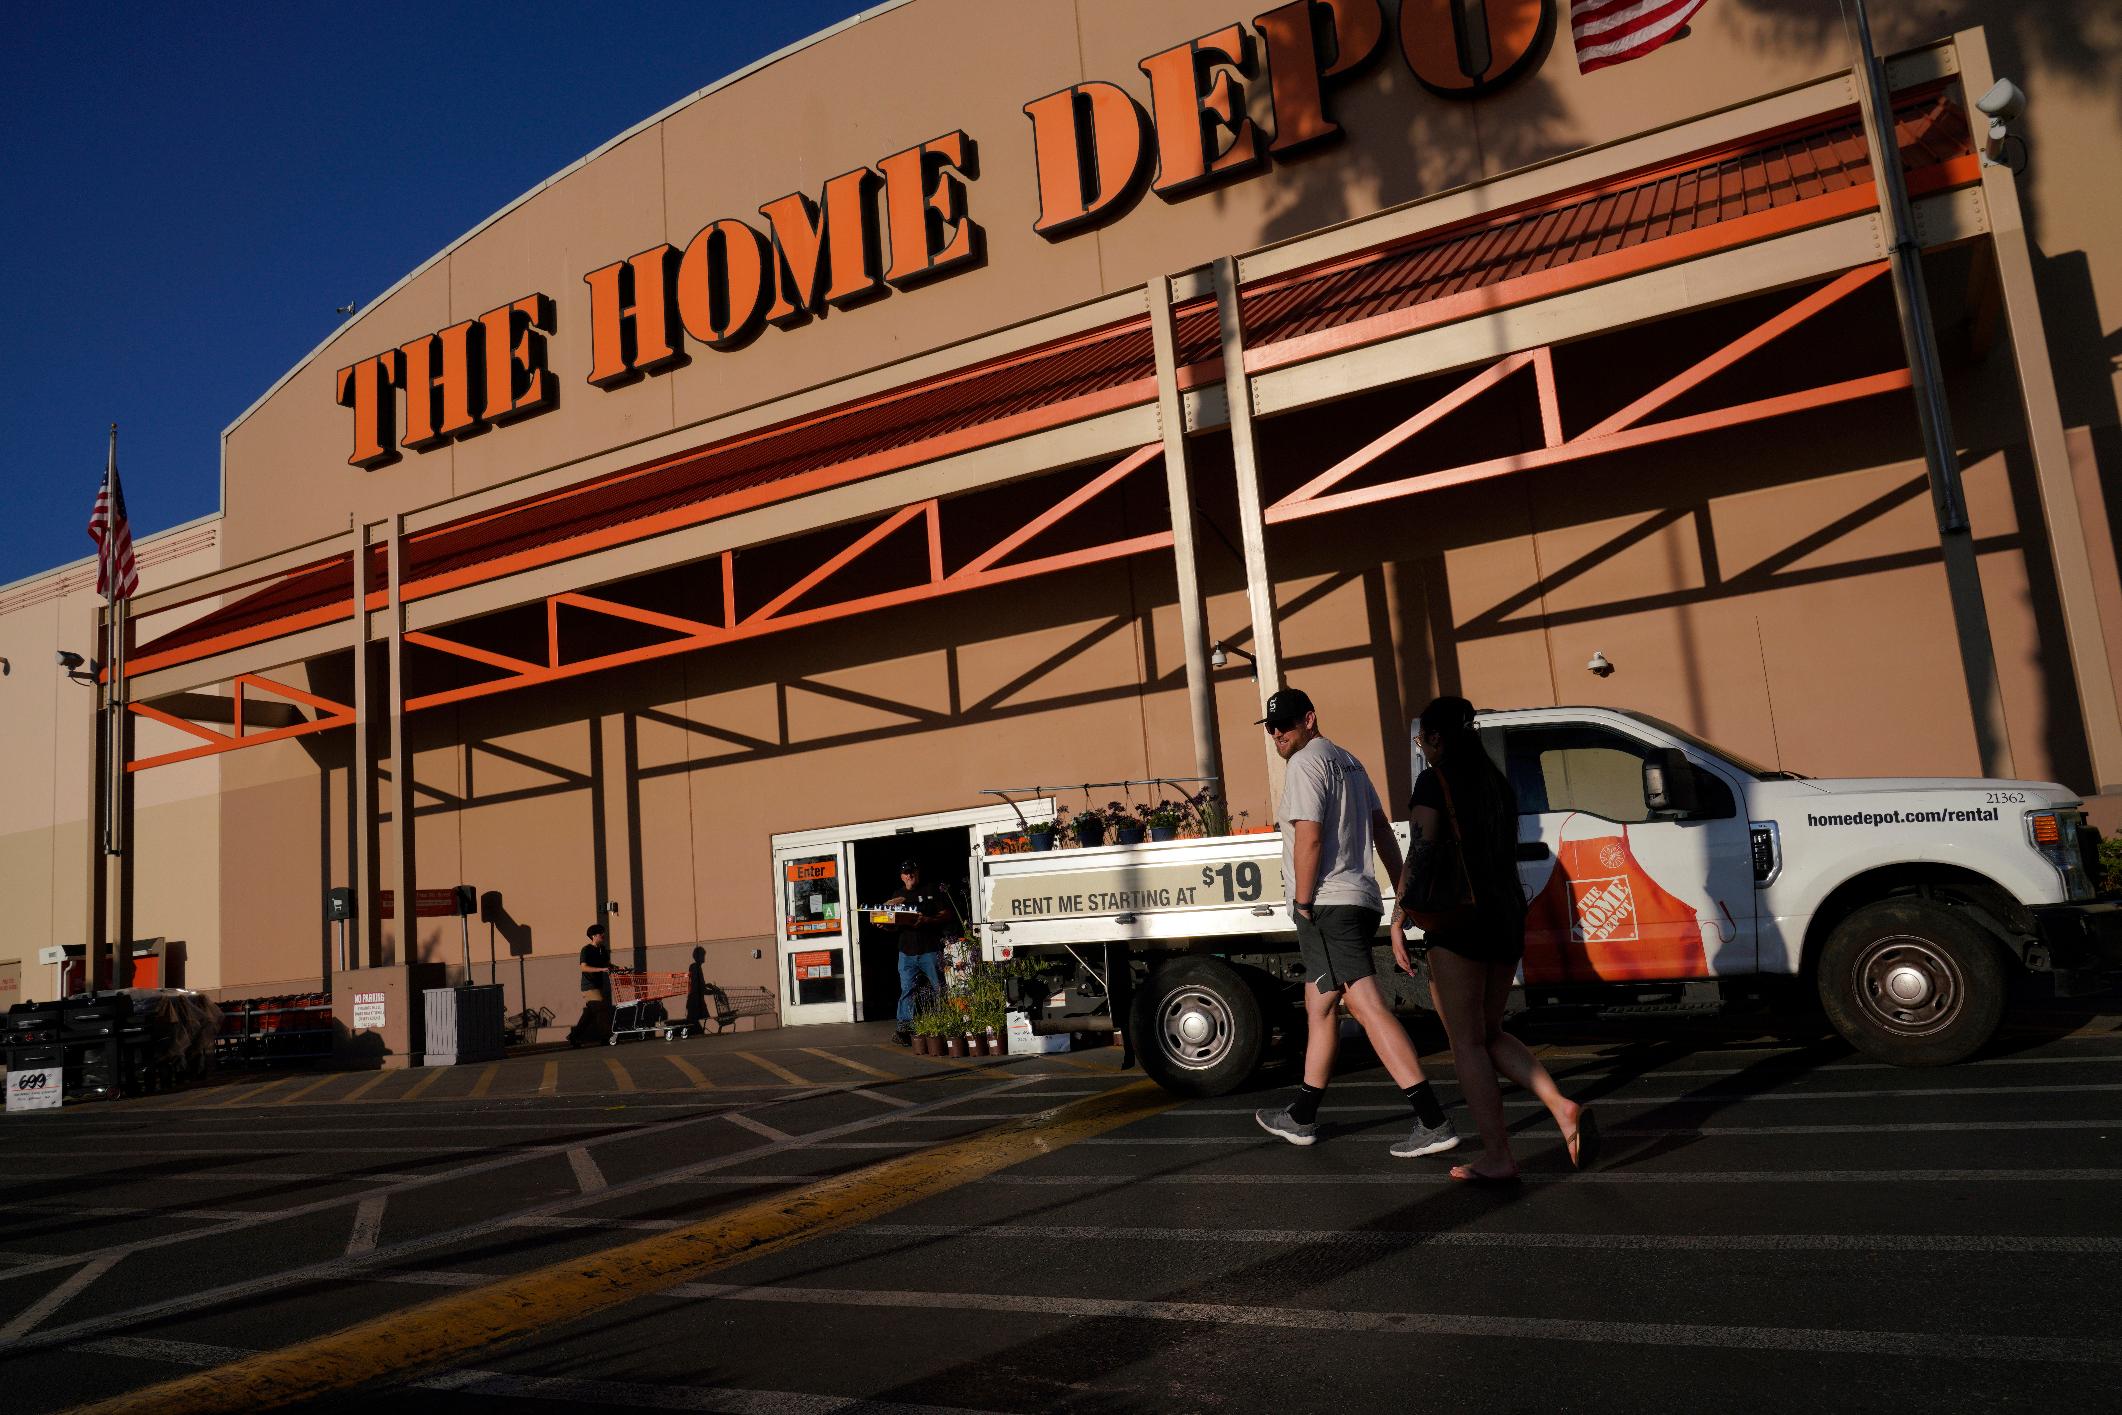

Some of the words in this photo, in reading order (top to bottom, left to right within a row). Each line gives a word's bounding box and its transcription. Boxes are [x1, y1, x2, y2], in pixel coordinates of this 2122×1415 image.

[336, 291, 560, 470] THE
[584, 129, 988, 391] HOME
[1986, 792, 2026, 804] 21362
[1807, 807, 1999, 827] homedepot.com/rental
[797, 865, 826, 879] Enter
[1012, 896, 1053, 916] RENT
[1058, 894, 1083, 913] ME
[1088, 888, 1170, 911] STARTING
[1175, 886, 1196, 906] AT
[1201, 861, 1263, 902] $19
[1576, 886, 1602, 911] THE
[825, 907, 834, 917] A
[1571, 879, 1629, 940] HOME
[1596, 899, 1633, 939] DEPOT
[354, 994, 362, 1004] NO
[362, 992, 385, 1003] PARKING
[19, 1073, 47, 1090] 699
